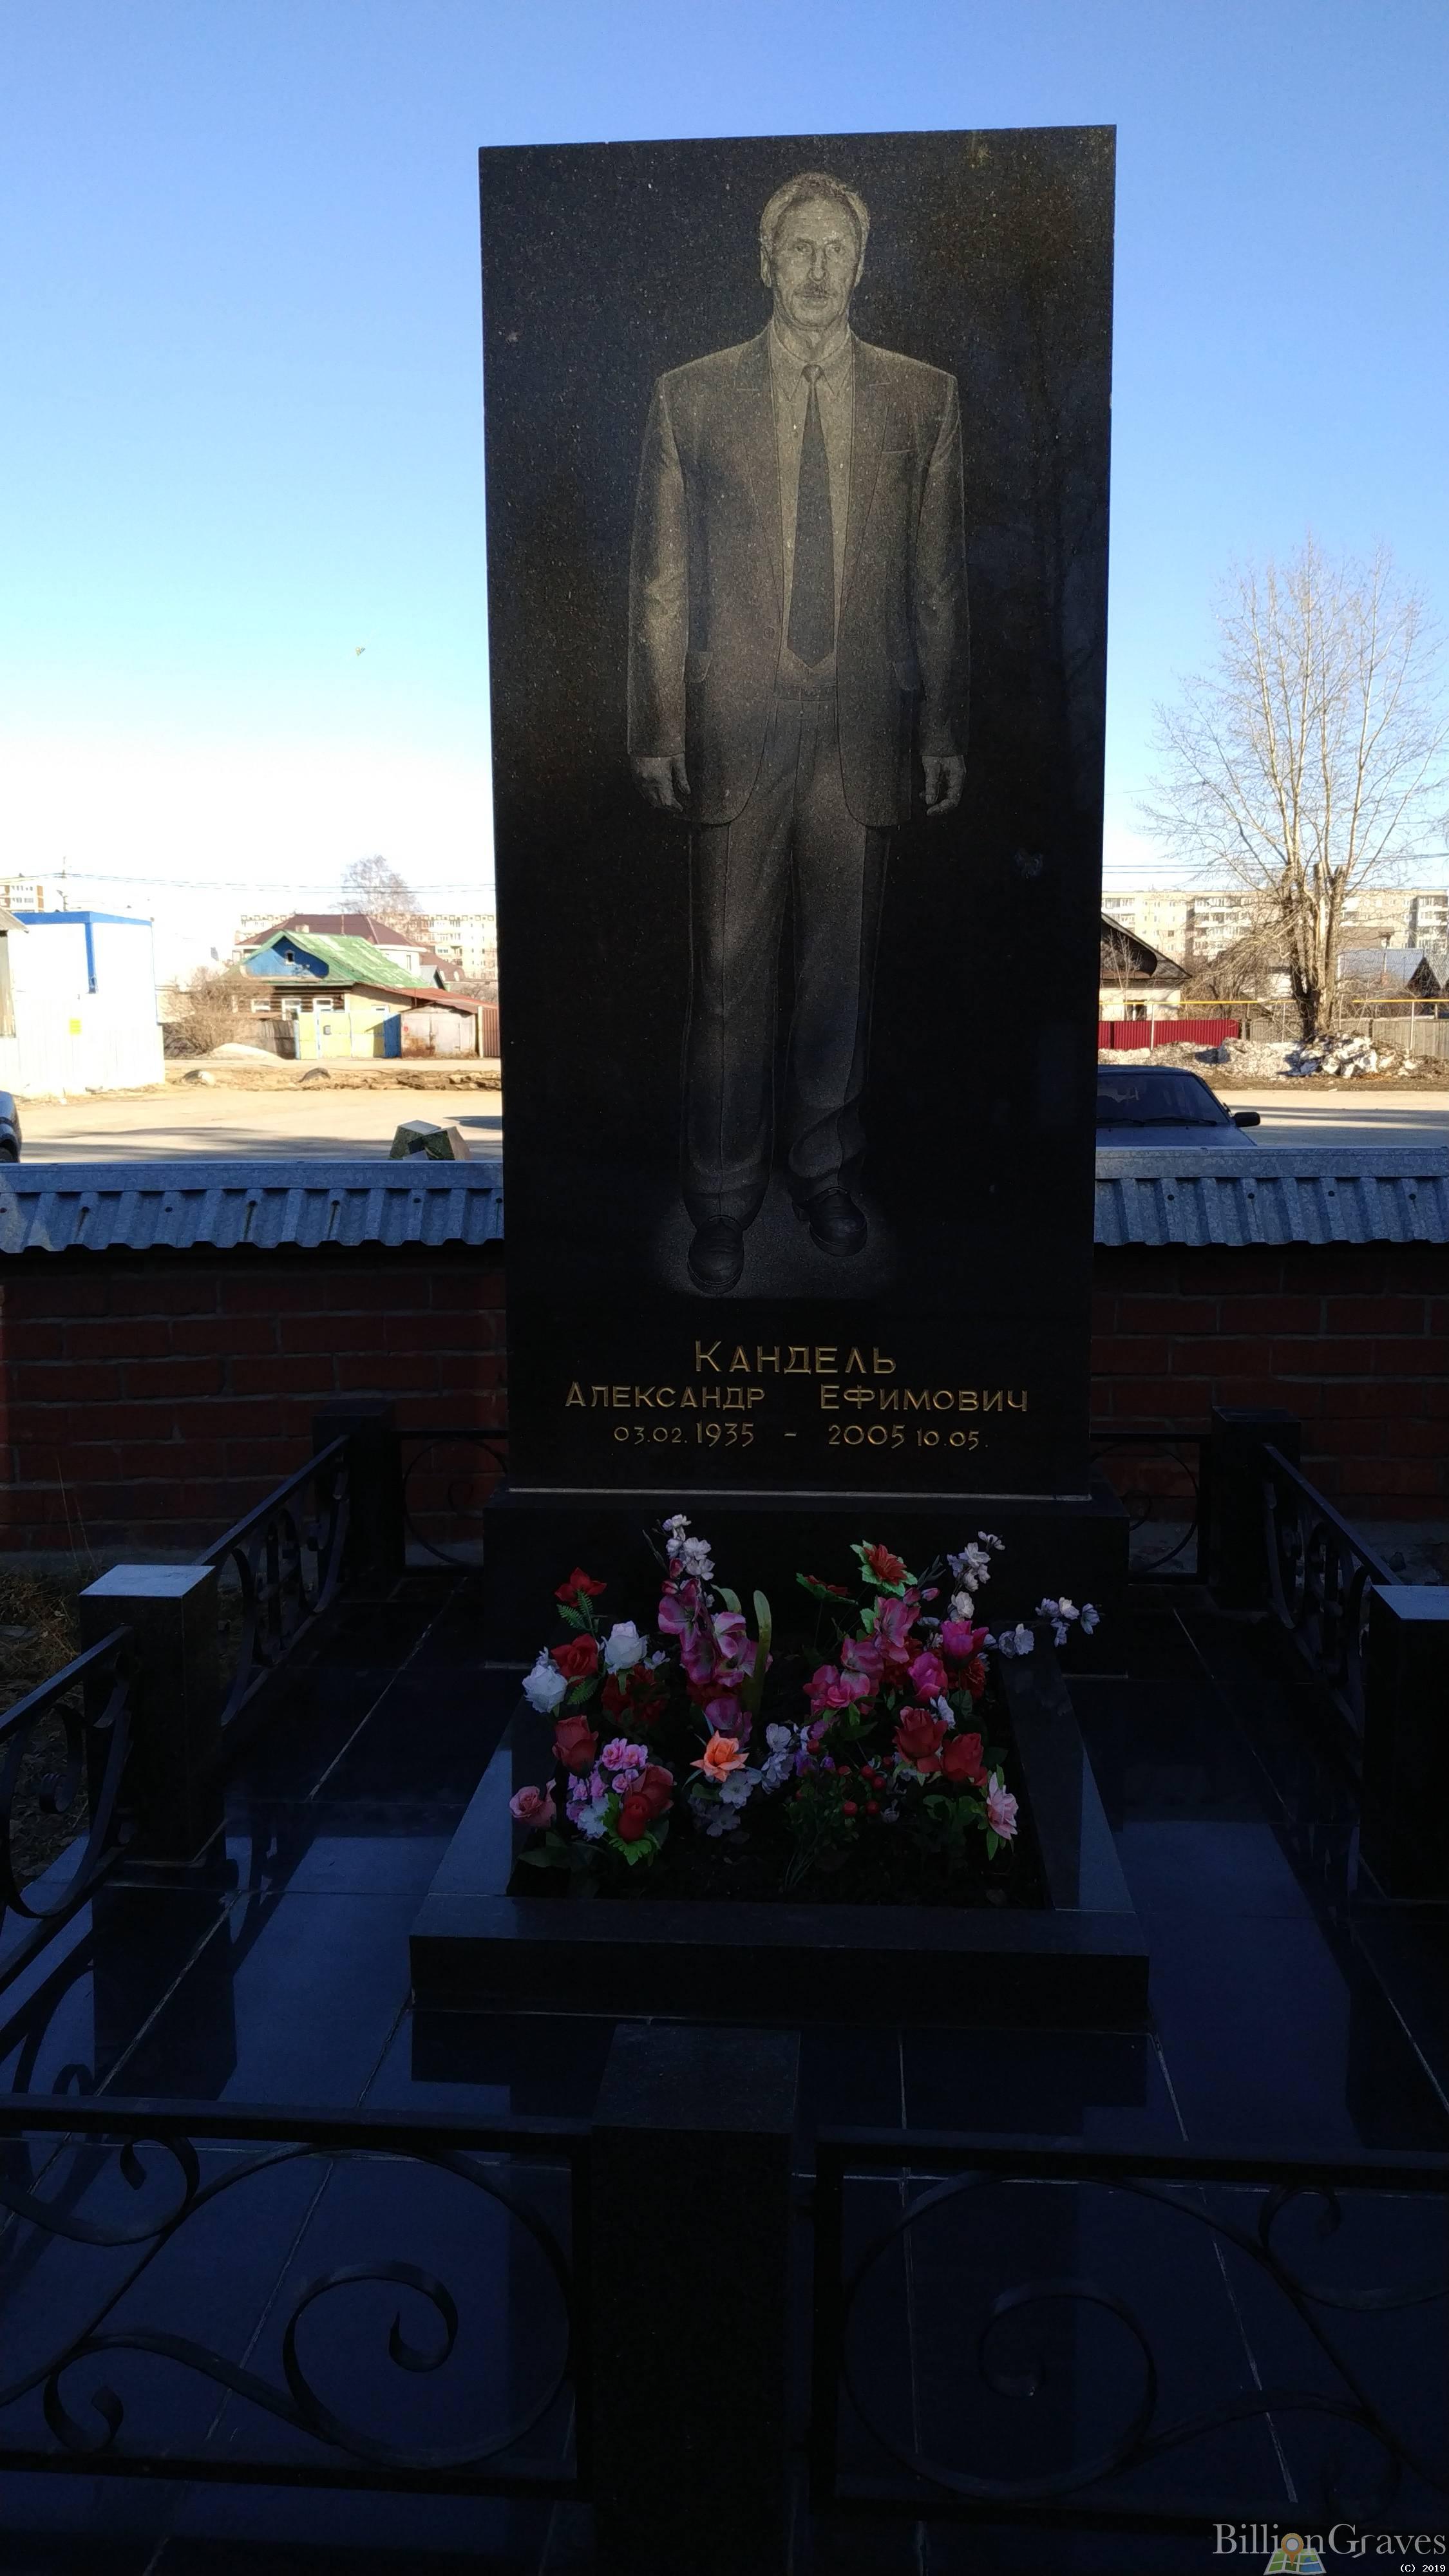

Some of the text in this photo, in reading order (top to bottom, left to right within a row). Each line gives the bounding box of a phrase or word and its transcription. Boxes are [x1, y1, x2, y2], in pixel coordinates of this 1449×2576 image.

[695, 1340, 897, 1375] КАНДЕЛЬ
[565, 1381, 1028, 1412] АЛЕКСАНДР ЕФИМОВИЧ
[696, 1419, 754, 1447] 1935
[828, 1423, 905, 1449] 2005
